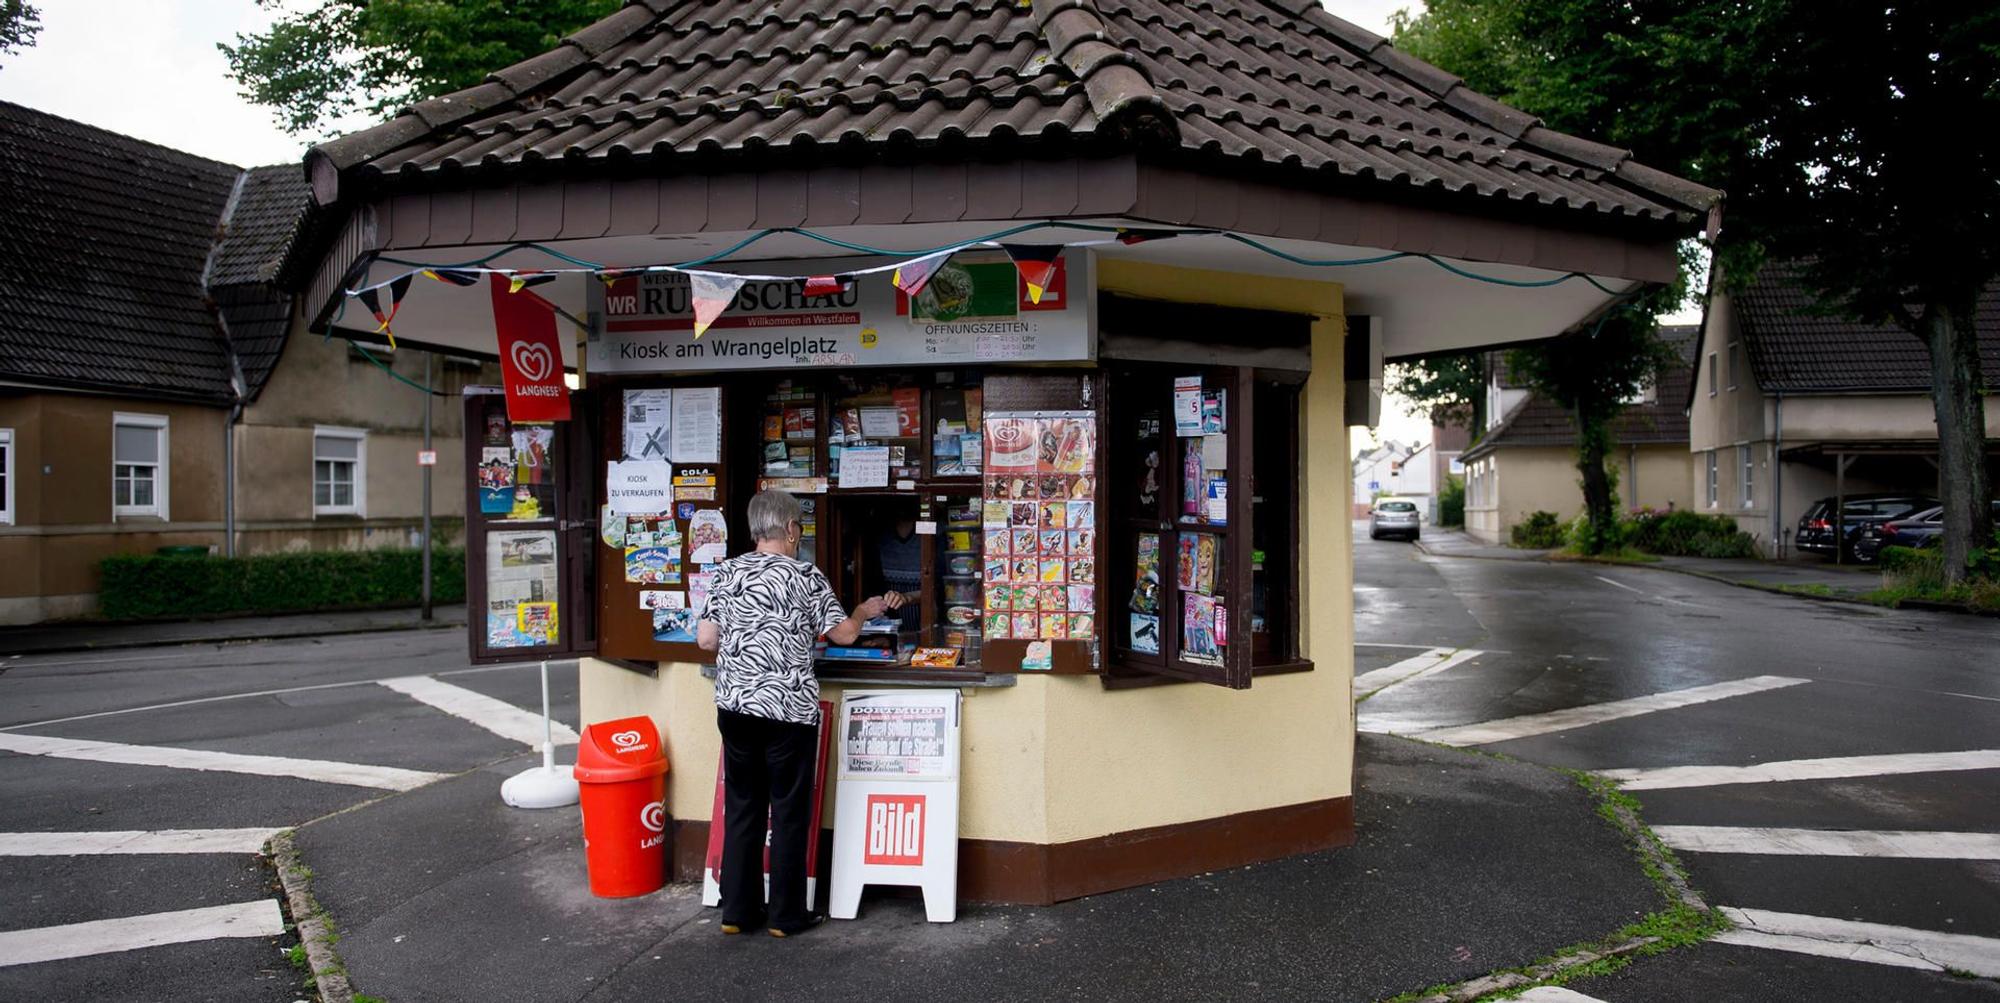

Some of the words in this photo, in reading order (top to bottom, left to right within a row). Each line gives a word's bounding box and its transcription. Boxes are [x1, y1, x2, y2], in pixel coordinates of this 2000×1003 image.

[607, 297, 638, 315] WR
[748, 316, 800, 327] Willkommen
[802, 316, 811, 325] in
[814, 314, 858, 325] Westfalen.
[621, 340, 669, 359] Kiosk
[676, 344, 704, 357] am
[712, 336, 837, 360] Wrangelplatz
[516, 385, 560, 397] LANGNESE
[681, 468, 709, 476] COLA
[611, 489, 620, 497] ZU
[621, 489, 664, 497] VERKAUFEN
[870, 802, 921, 857] Bild
